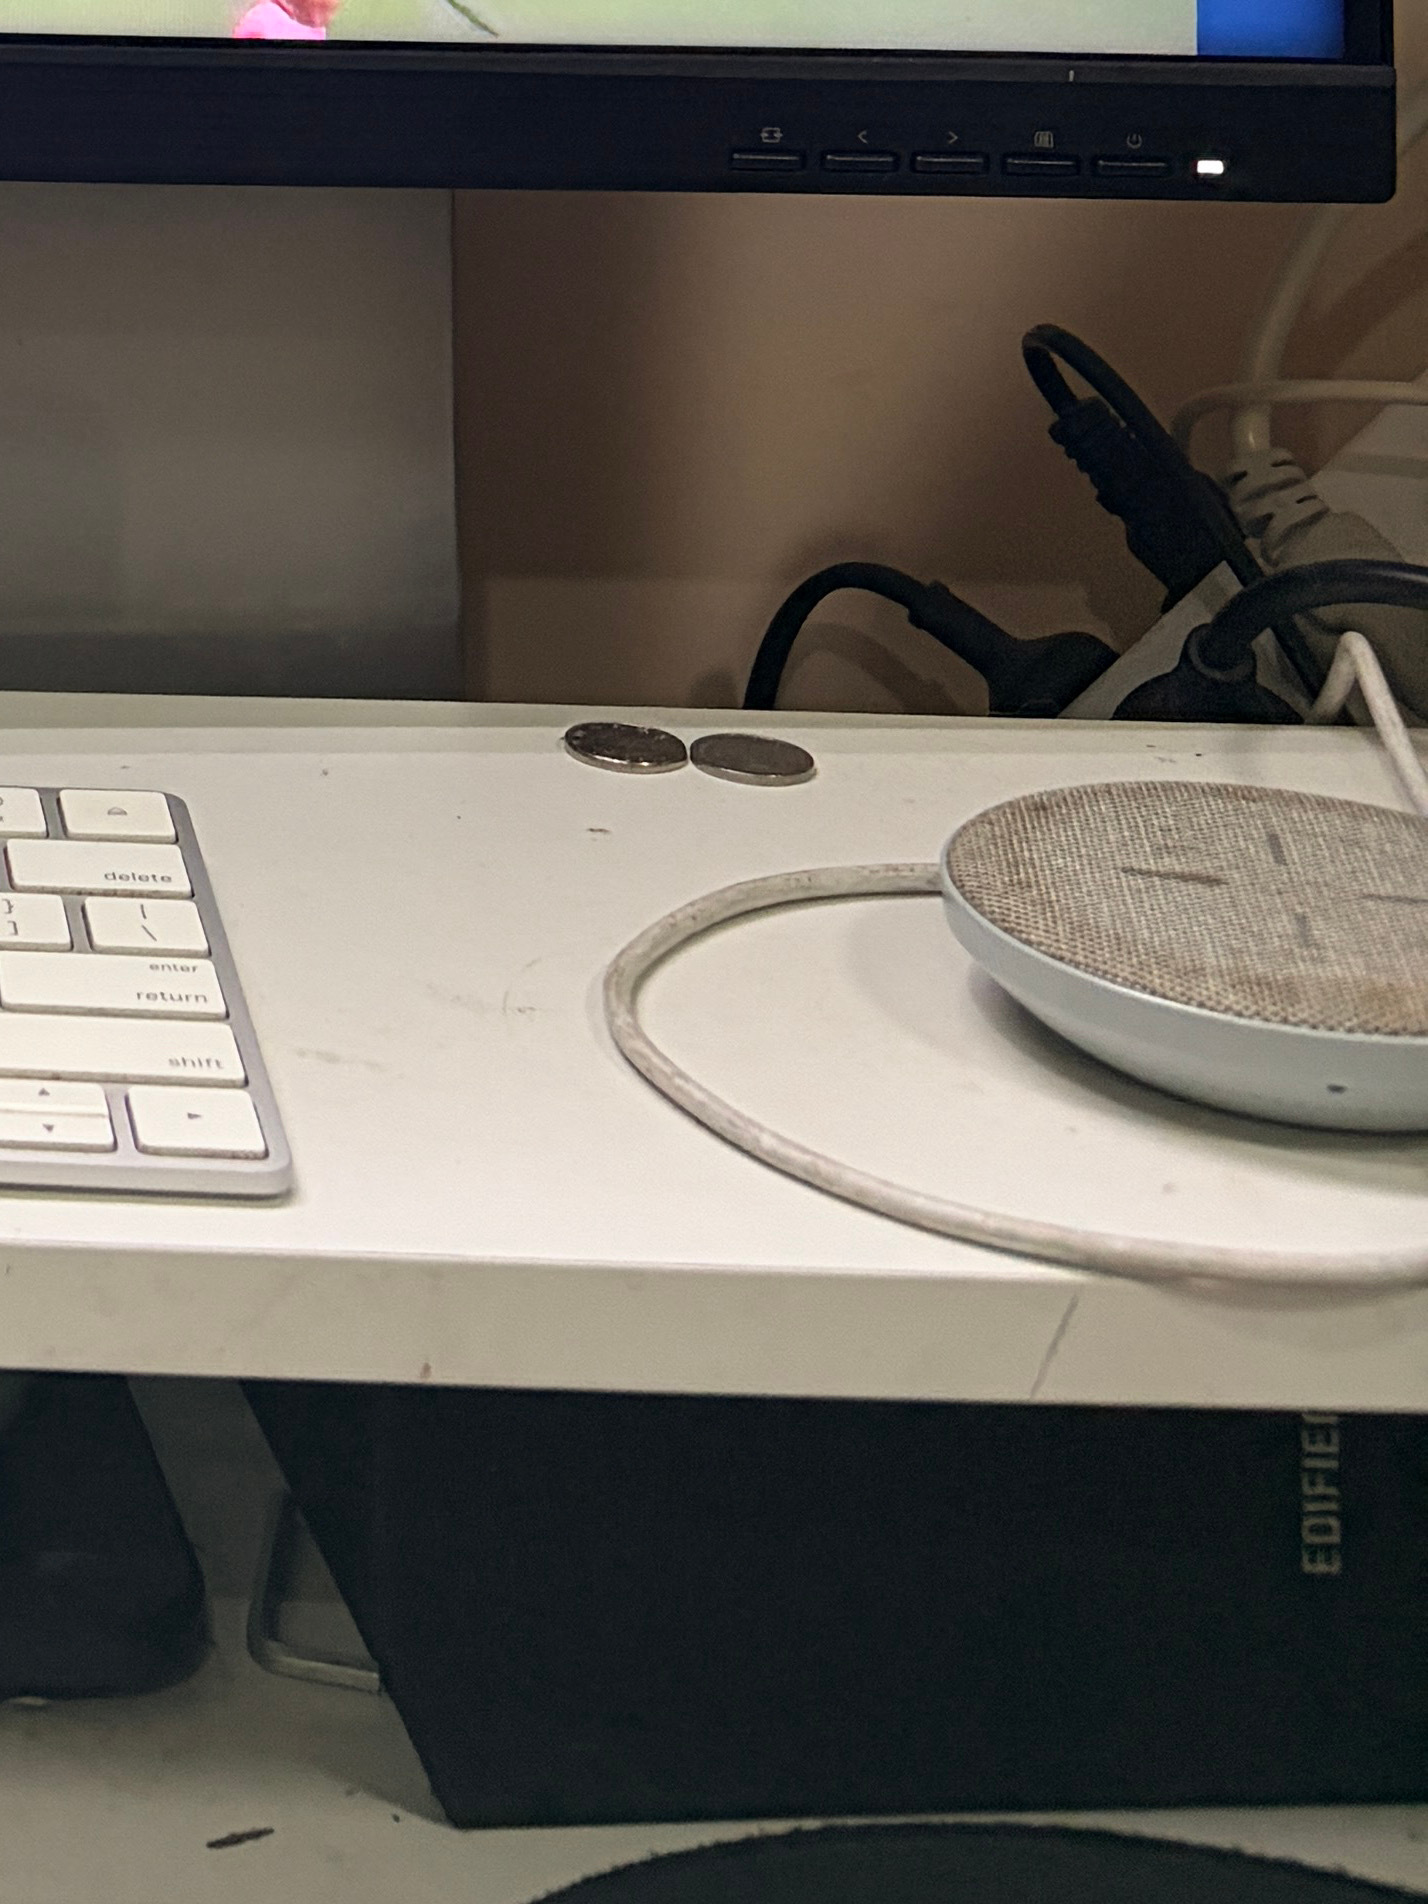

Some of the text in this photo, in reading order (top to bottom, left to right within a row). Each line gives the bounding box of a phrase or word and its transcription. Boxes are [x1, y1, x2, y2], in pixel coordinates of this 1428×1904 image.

[103, 871, 172, 883] delete
[148, 960, 199, 974] enter
[136, 991, 208, 1003] return
[168, 1056, 222, 1069] shift
